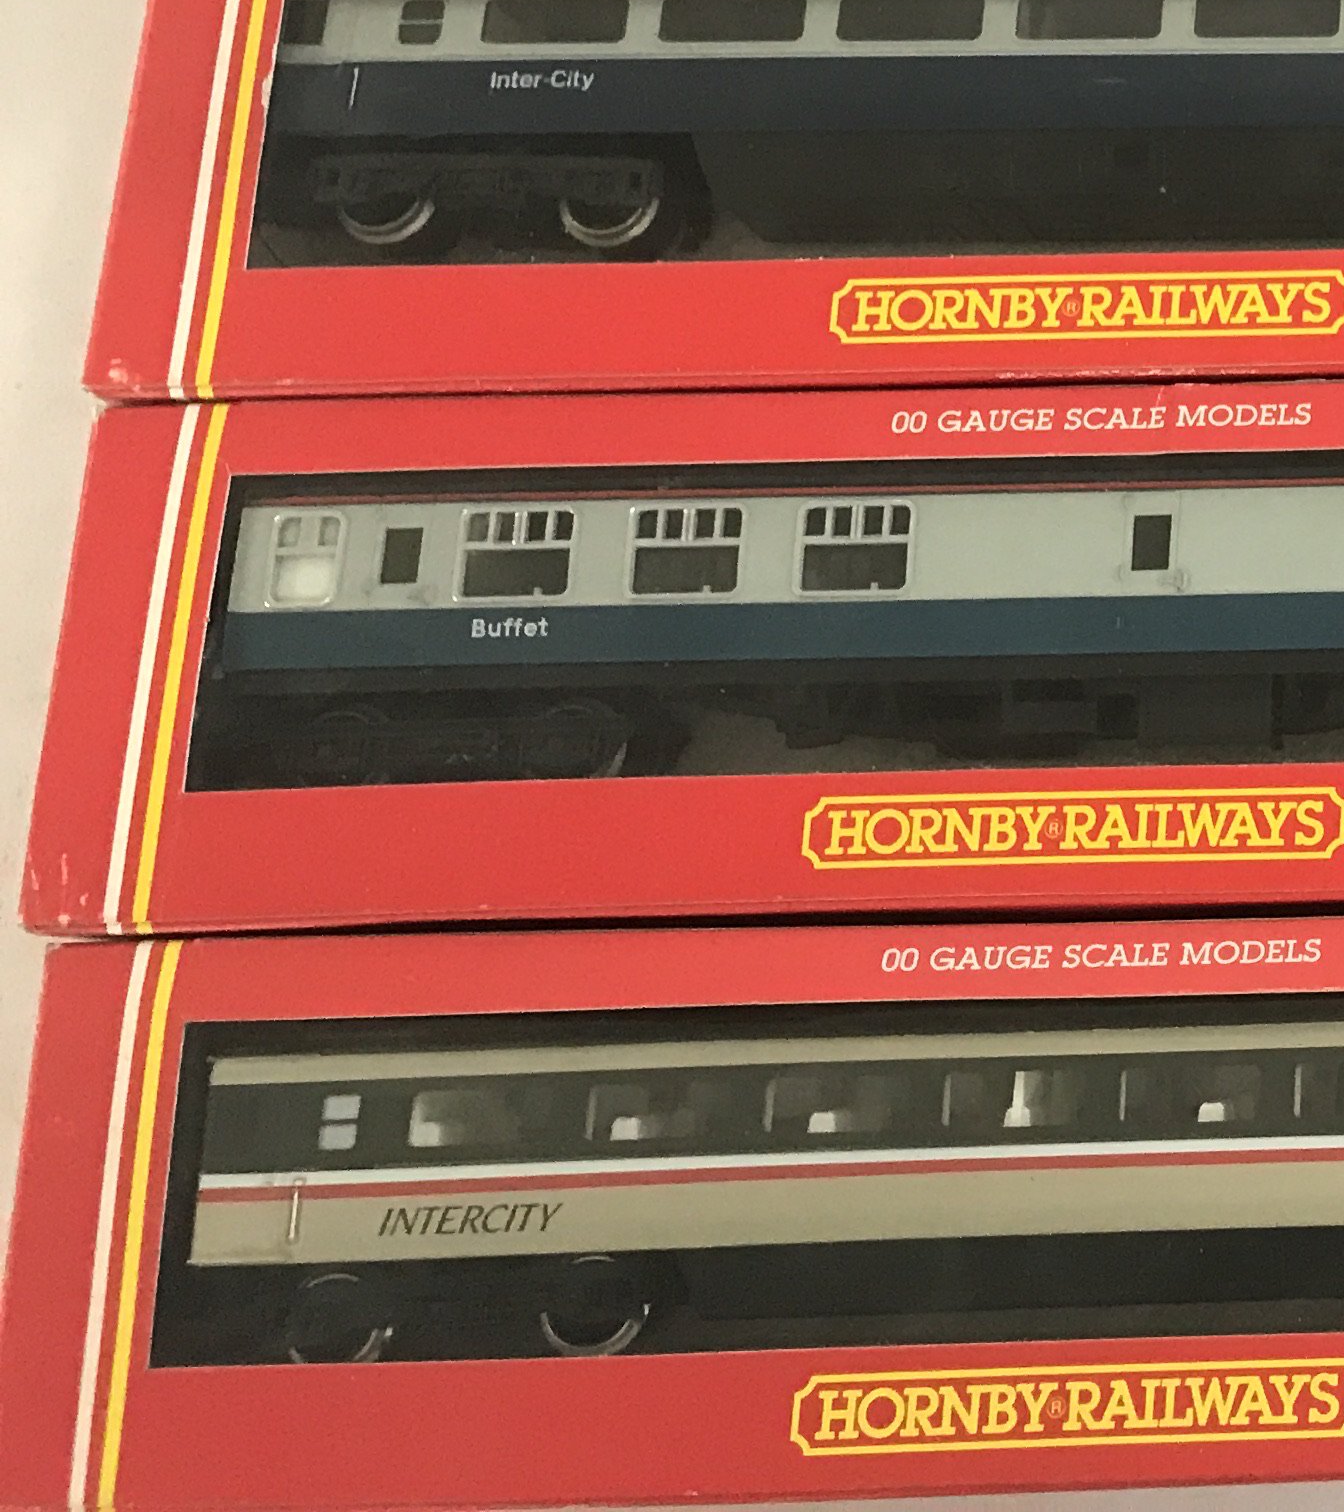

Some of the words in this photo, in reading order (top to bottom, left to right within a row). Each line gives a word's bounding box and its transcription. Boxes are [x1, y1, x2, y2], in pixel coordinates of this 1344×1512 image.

[490, 70, 594, 91] Inter-City
[1078, 282, 1330, 326] RAILWAYS
[937, 408, 1055, 433] GAUGE
[1063, 406, 1167, 431] SCALE
[1175, 402, 1312, 427] MODELS
[471, 616, 549, 638] Buffet
[1060, 800, 1324, 849] RAILWAYS
[929, 945, 1053, 971] GAUGE
[1061, 942, 1170, 969] SCALE
[1179, 938, 1322, 966] MODELS
[378, 1203, 563, 1237] INTERCITY
[1063, 1373, 1339, 1430] RAILWAYS
